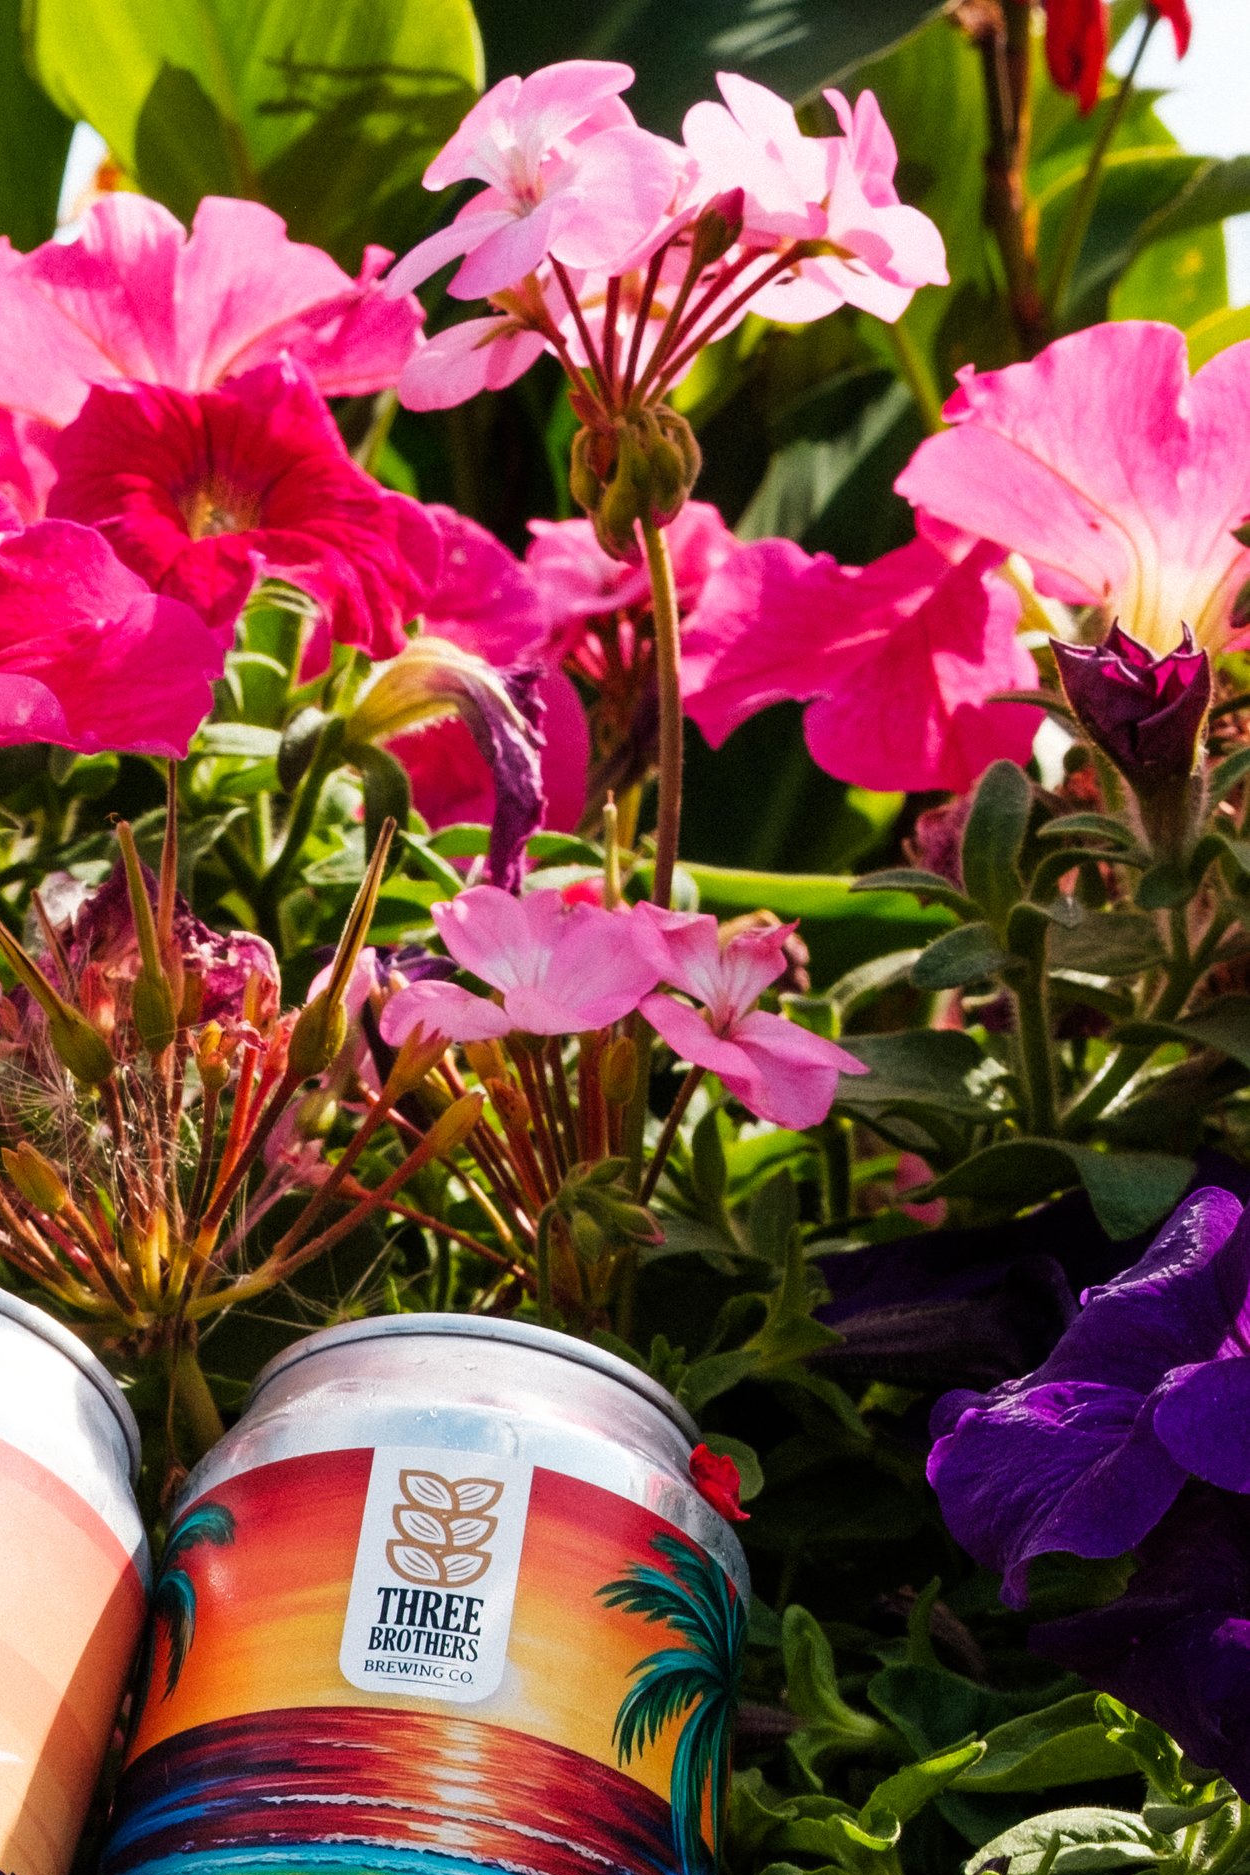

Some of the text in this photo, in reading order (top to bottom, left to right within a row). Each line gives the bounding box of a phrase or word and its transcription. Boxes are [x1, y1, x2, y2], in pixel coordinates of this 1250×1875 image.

[377, 1586, 484, 1636] THREE
[367, 1626, 480, 1663] BROTHERS
[364, 1660, 474, 1685] BREWING CO.
